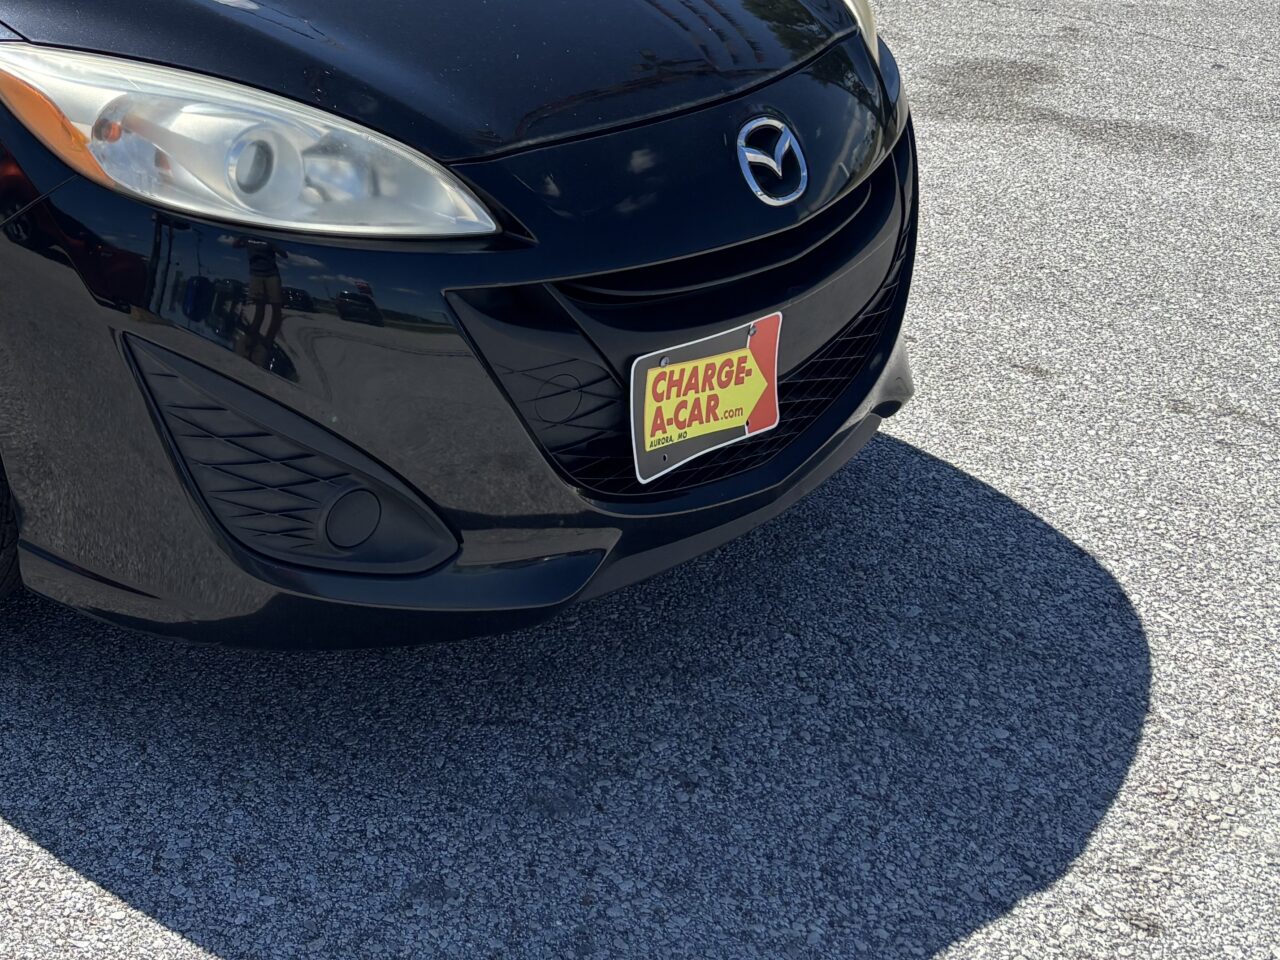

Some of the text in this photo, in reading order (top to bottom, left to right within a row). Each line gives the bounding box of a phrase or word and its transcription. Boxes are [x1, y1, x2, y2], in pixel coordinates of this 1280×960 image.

[651, 355, 752, 403] CHARGE-
[649, 431, 688, 448] AURORA, MO
